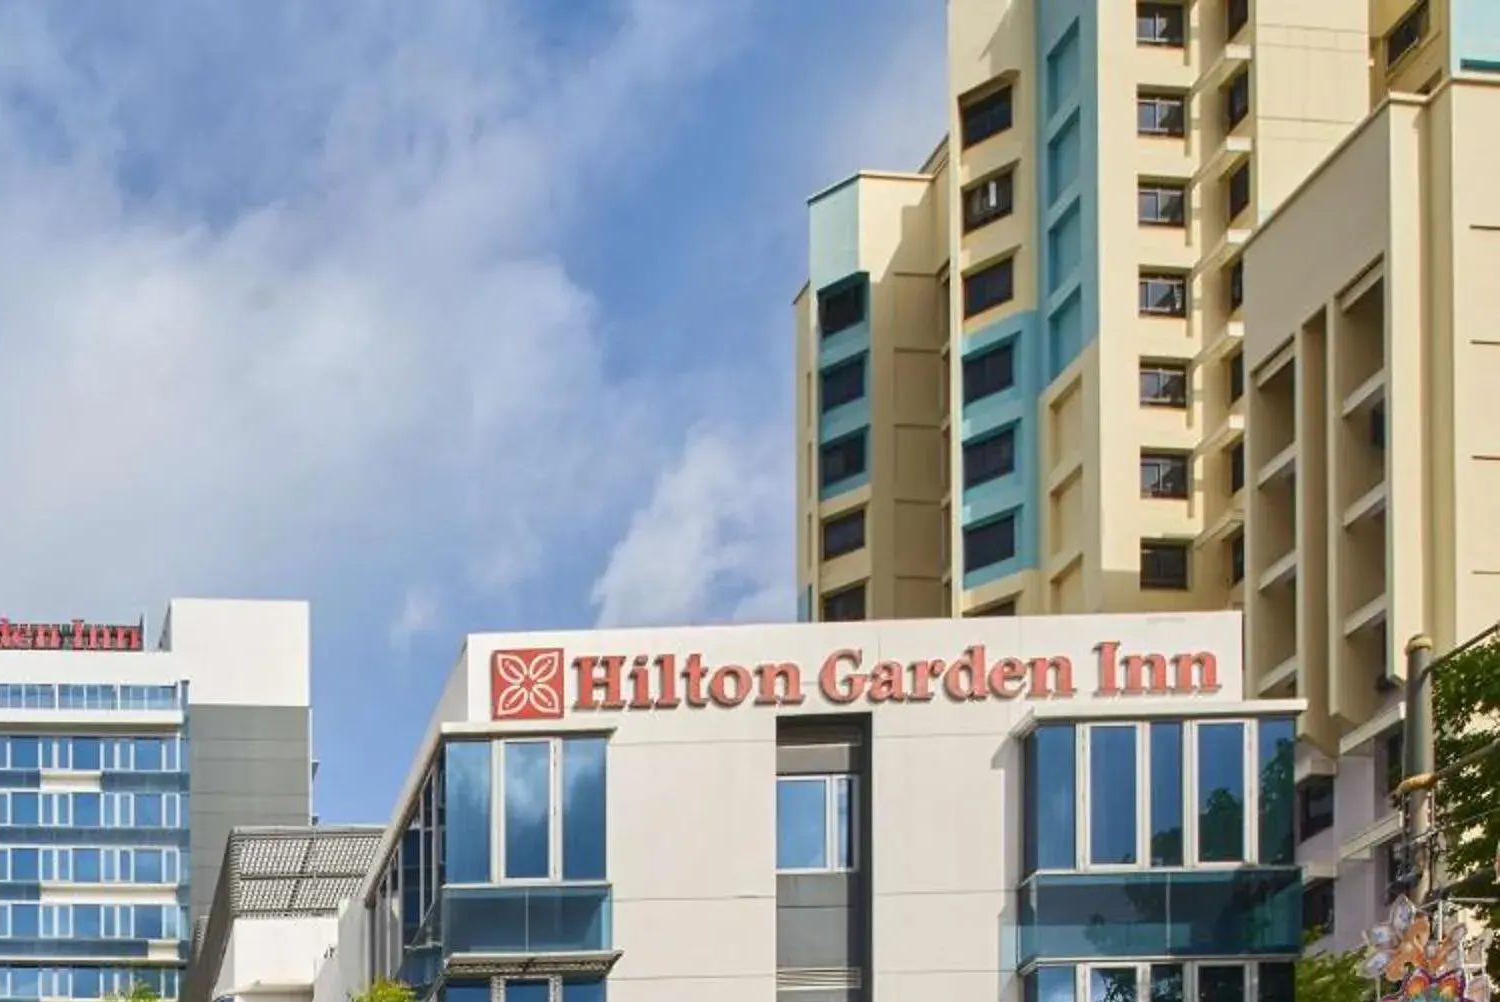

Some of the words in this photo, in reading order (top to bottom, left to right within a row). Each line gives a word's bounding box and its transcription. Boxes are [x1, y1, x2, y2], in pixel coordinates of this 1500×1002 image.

[71, 618, 143, 650] Inn
[572, 651, 805, 711] Hilton
[818, 645, 1080, 706] Garden
[1092, 640, 1222, 698] Inn
